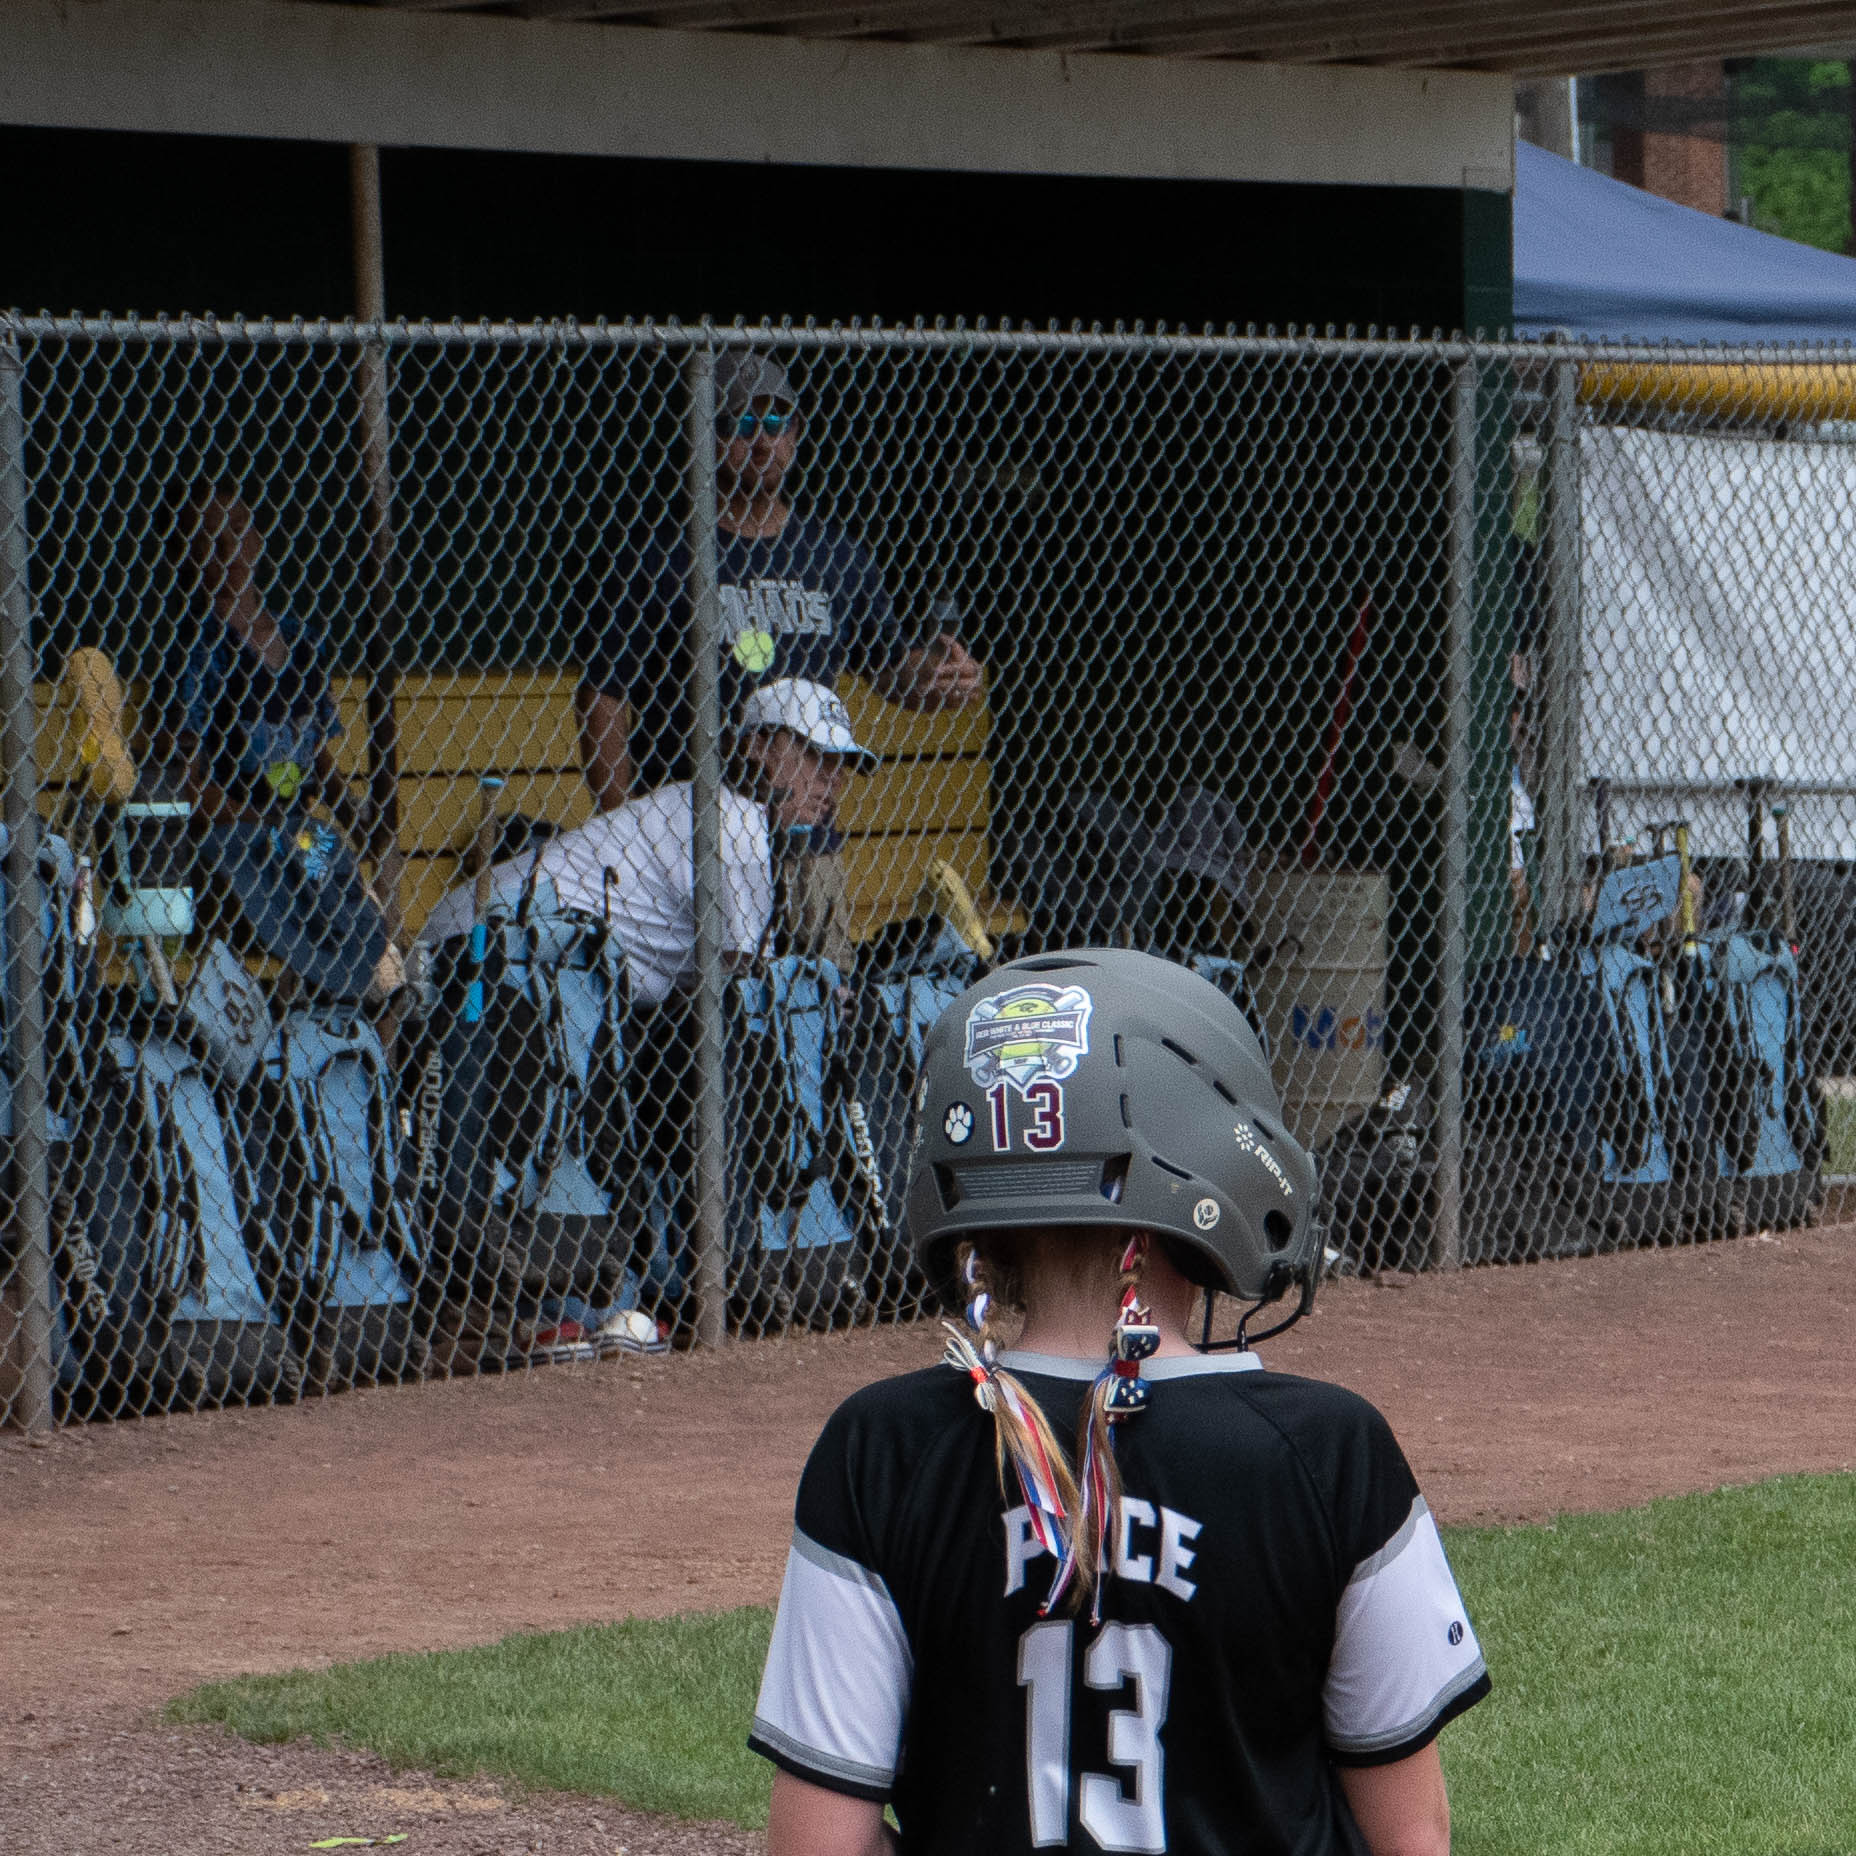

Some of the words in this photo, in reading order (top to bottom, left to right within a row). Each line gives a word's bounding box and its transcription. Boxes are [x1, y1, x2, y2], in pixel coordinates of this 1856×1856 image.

[1041, 1020, 1074, 1029] CLASSIC
[986, 1079, 1065, 1152] 13
[1254, 1144, 1293, 1197] RIP-IT
[1001, 1495, 1203, 1602] PCE
[1016, 1619, 1173, 1855] 13
